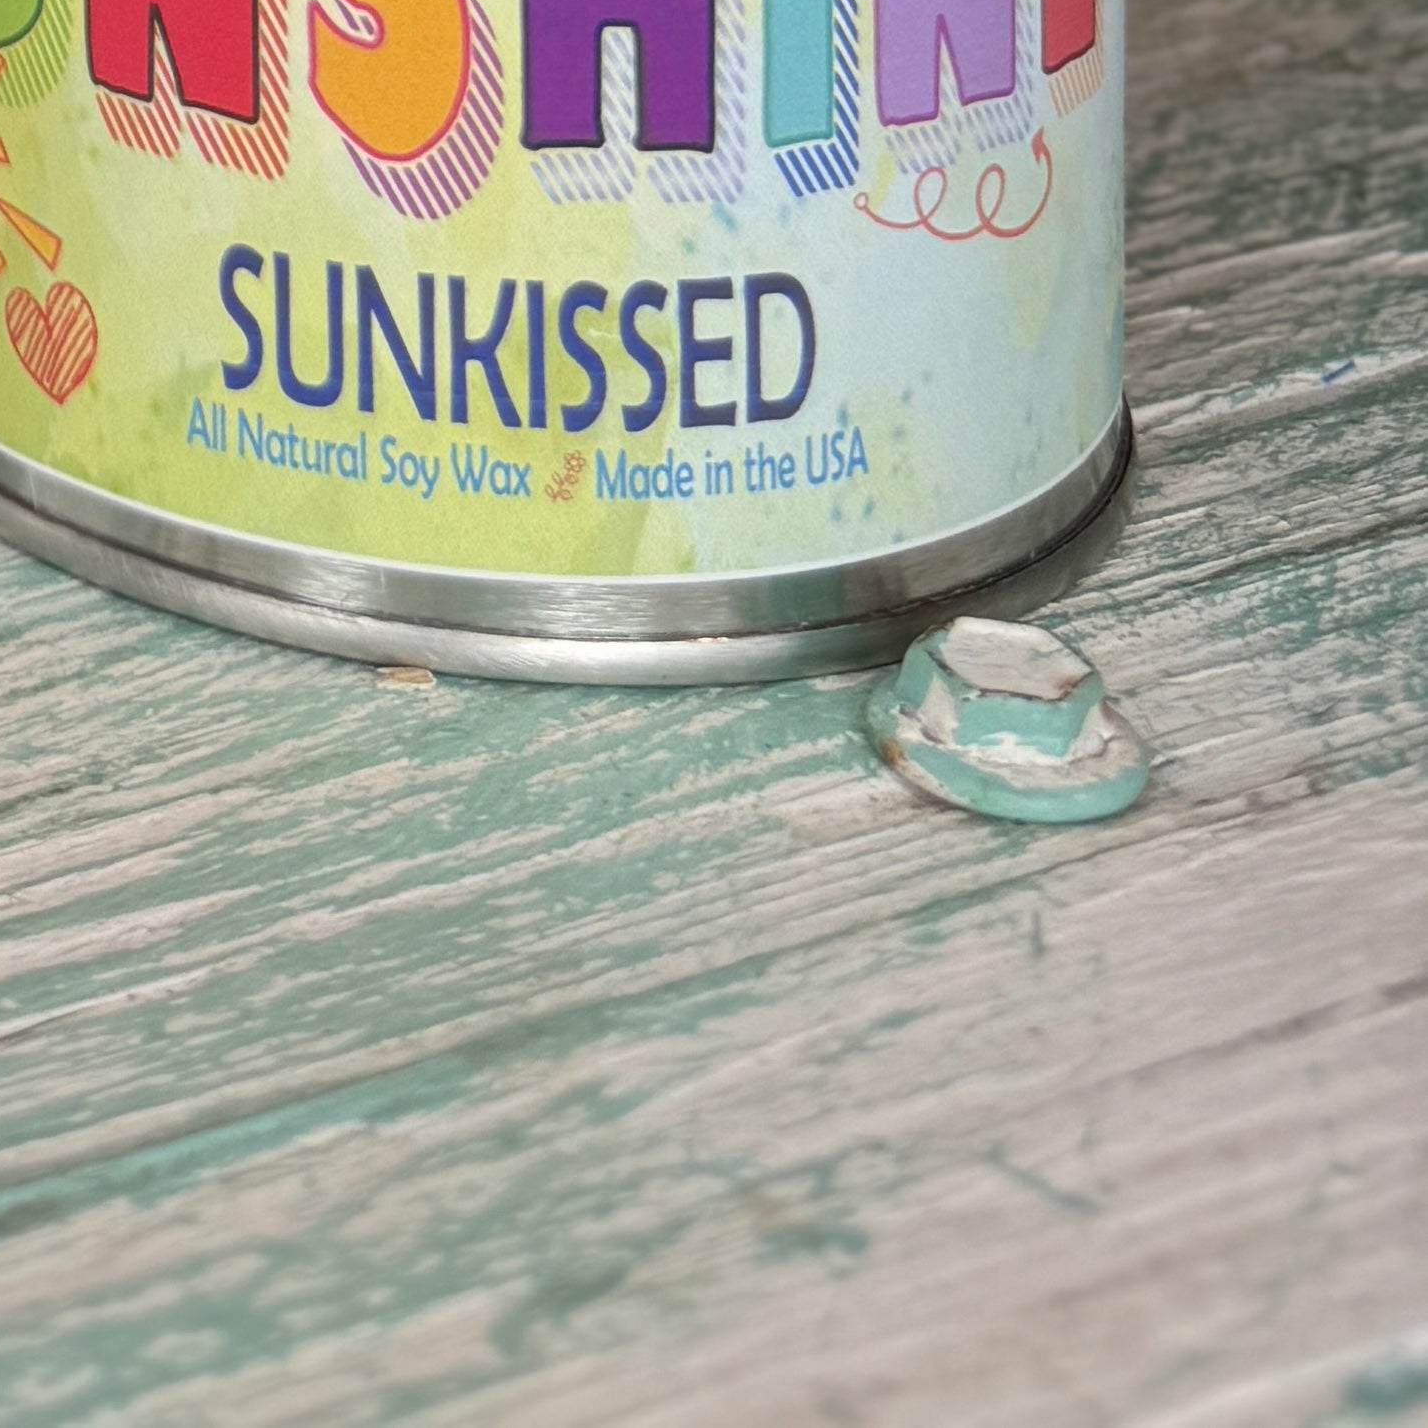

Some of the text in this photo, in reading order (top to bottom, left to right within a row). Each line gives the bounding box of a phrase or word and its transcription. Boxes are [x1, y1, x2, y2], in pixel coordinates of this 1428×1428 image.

[218, 242, 817, 434] SUNKISSED
[186, 397, 869, 502] All Natural Soy Wax Made in the USA
